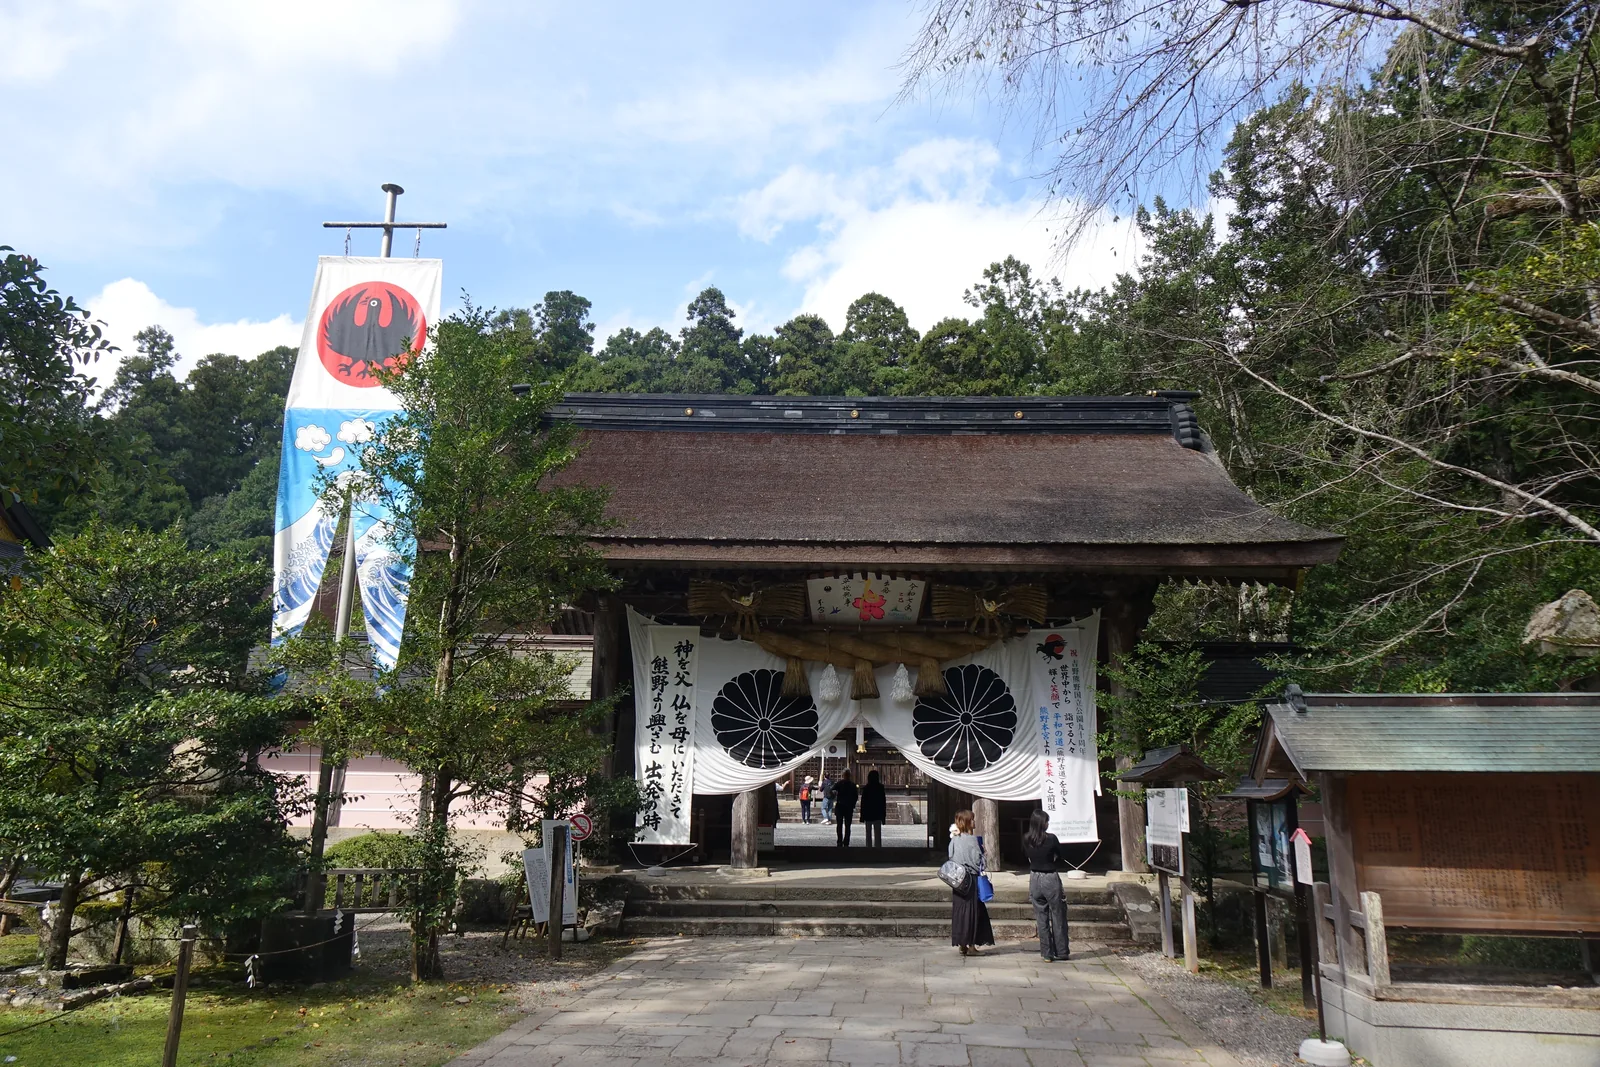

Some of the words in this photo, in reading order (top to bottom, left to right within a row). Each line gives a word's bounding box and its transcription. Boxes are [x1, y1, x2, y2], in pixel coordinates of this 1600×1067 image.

[673, 639, 694, 688] 神を父
[1069, 649, 1078, 657] 祝
[645, 655, 669, 754] 熊野より興さむ
[1048, 668, 1061, 709] 輝く笑顔で
[1060, 664, 1071, 705] 世界中から
[1071, 659, 1086, 756] 吉野熊野国立公園九十周年
[668, 694, 691, 755] 仏を母に
[1039, 706, 1051, 756] 熊野本宮より
[1064, 712, 1076, 754] 詣でる人々
[643, 760, 664, 832] 出発の時
[670, 760, 685, 819] いただきて
[1044, 759, 1056, 812] 未来へと前進
